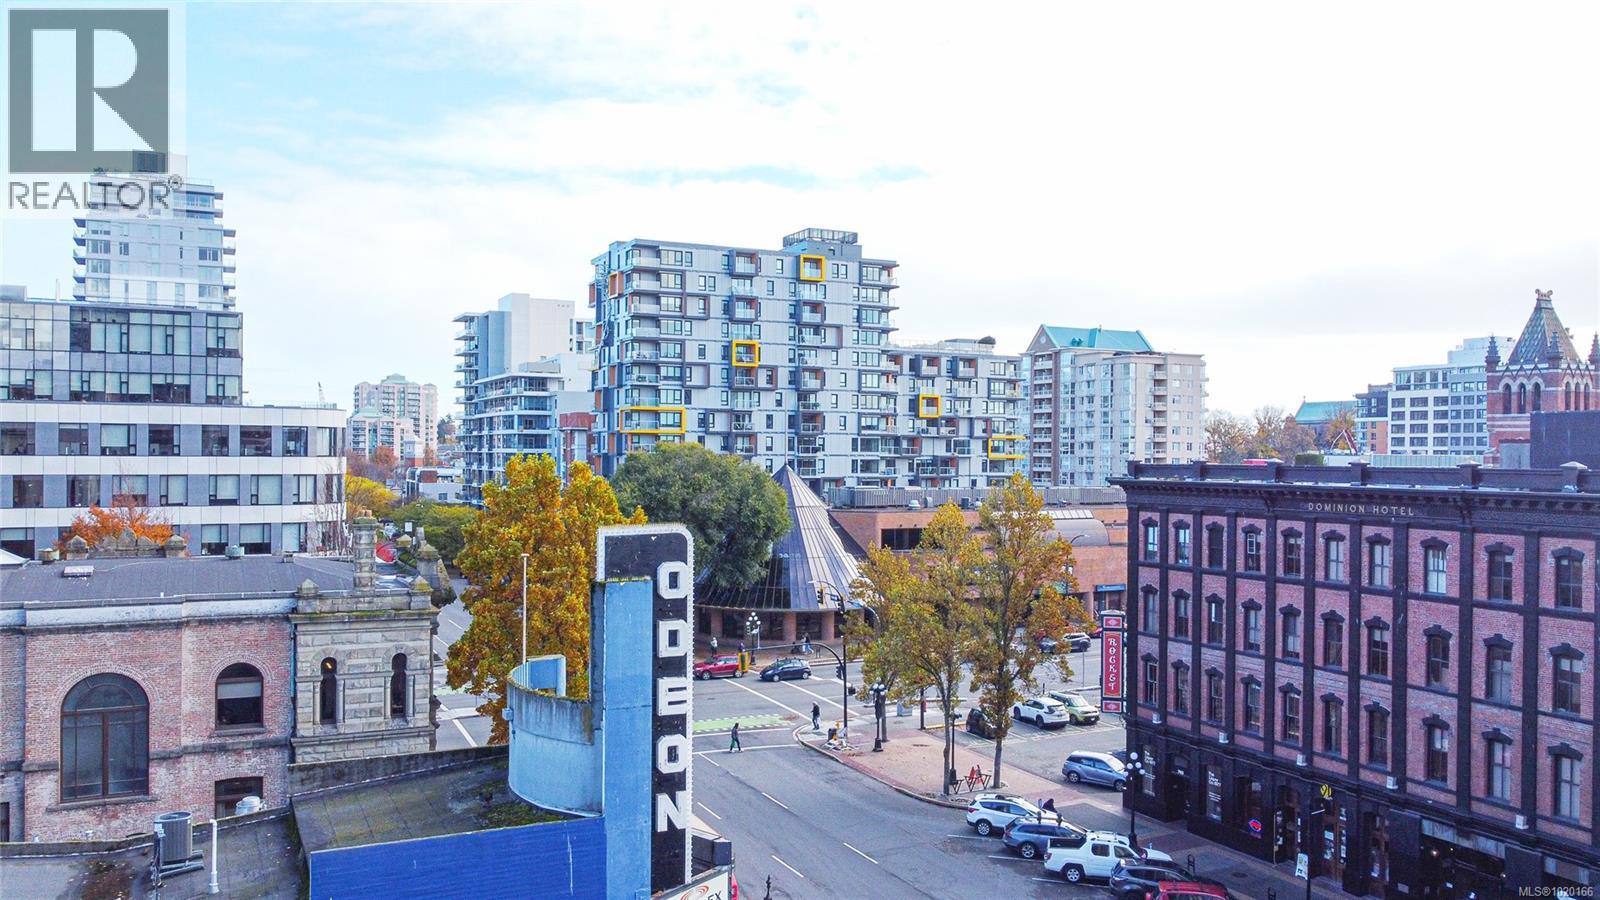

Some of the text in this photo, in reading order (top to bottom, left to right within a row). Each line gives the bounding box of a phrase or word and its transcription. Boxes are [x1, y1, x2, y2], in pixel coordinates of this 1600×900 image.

[1308, 502, 1414, 516] DOMINION HOTEL
[1107, 638, 1118, 690] ROCKET
[656, 560, 689, 832] ODEON
